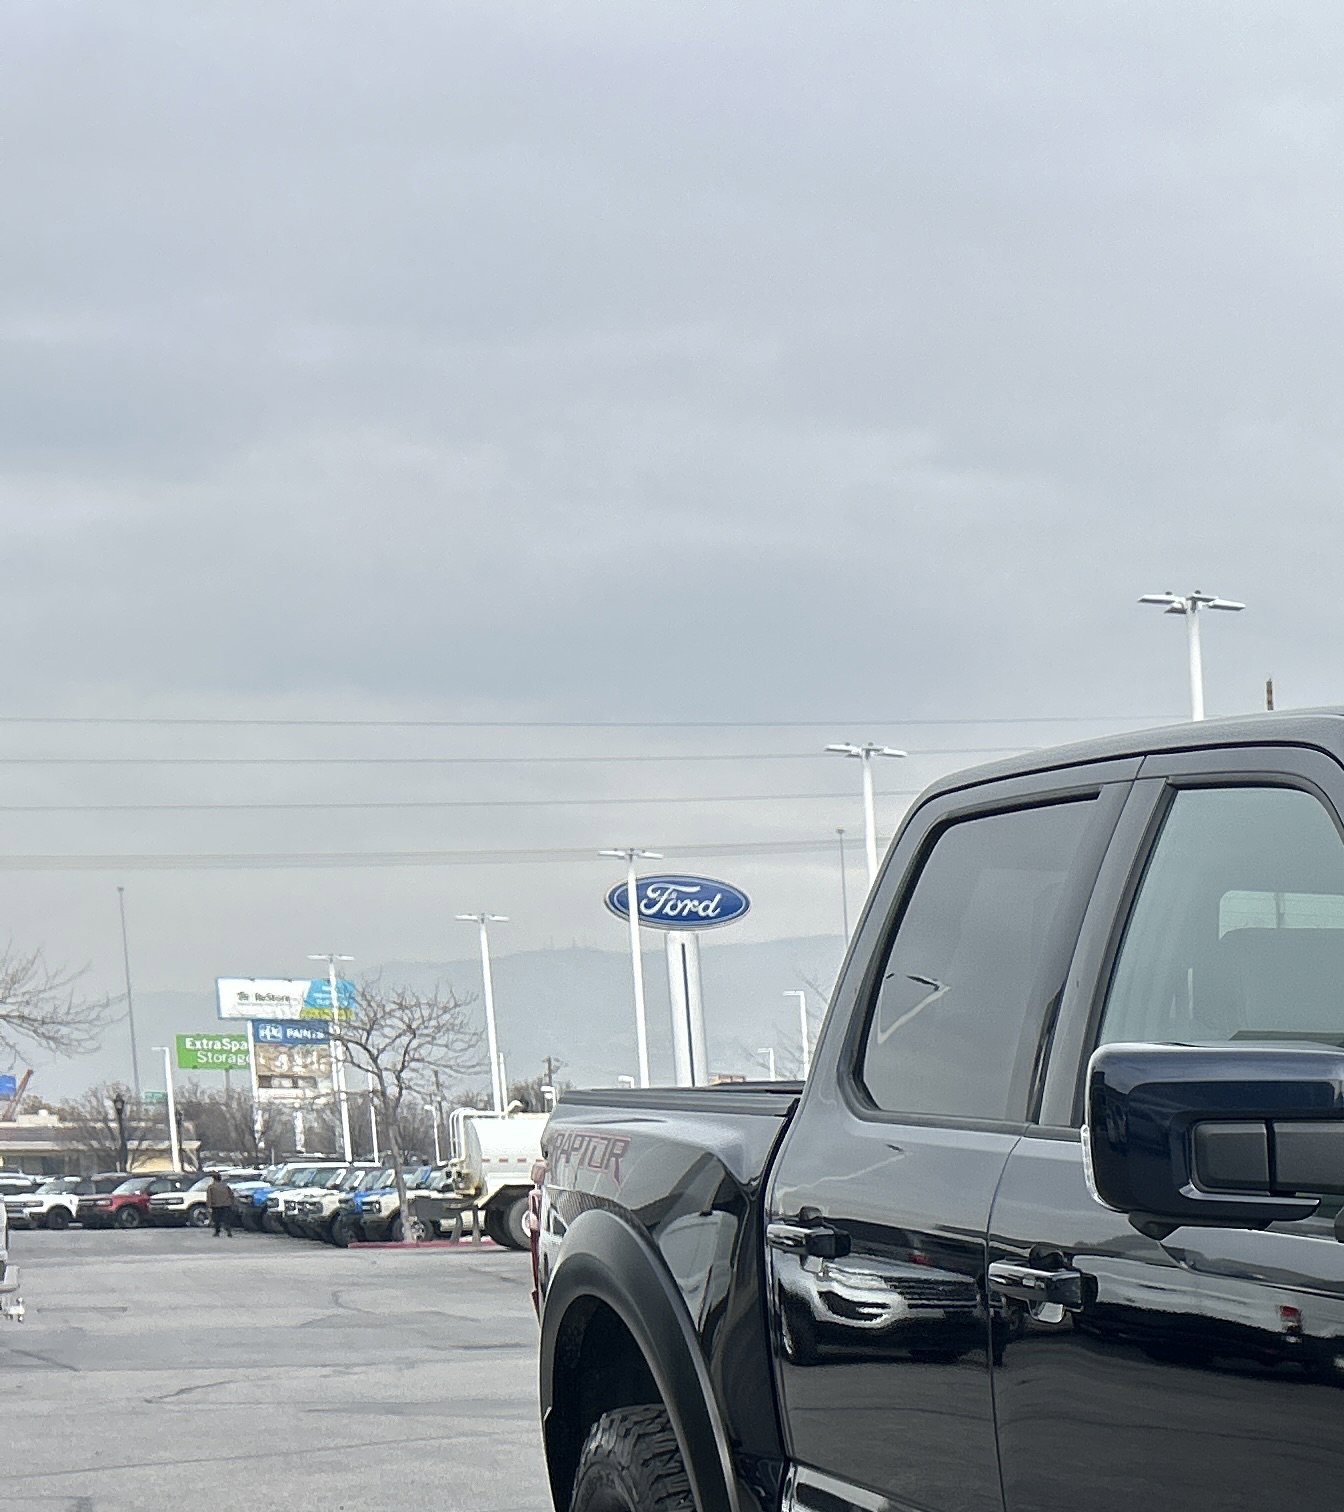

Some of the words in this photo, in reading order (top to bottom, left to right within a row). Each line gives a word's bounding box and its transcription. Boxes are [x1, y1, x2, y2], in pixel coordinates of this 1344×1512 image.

[639, 882, 722, 917] Ford
[185, 1037, 248, 1052] ExtraSpa
[551, 1130, 632, 1191] RAPTOR
